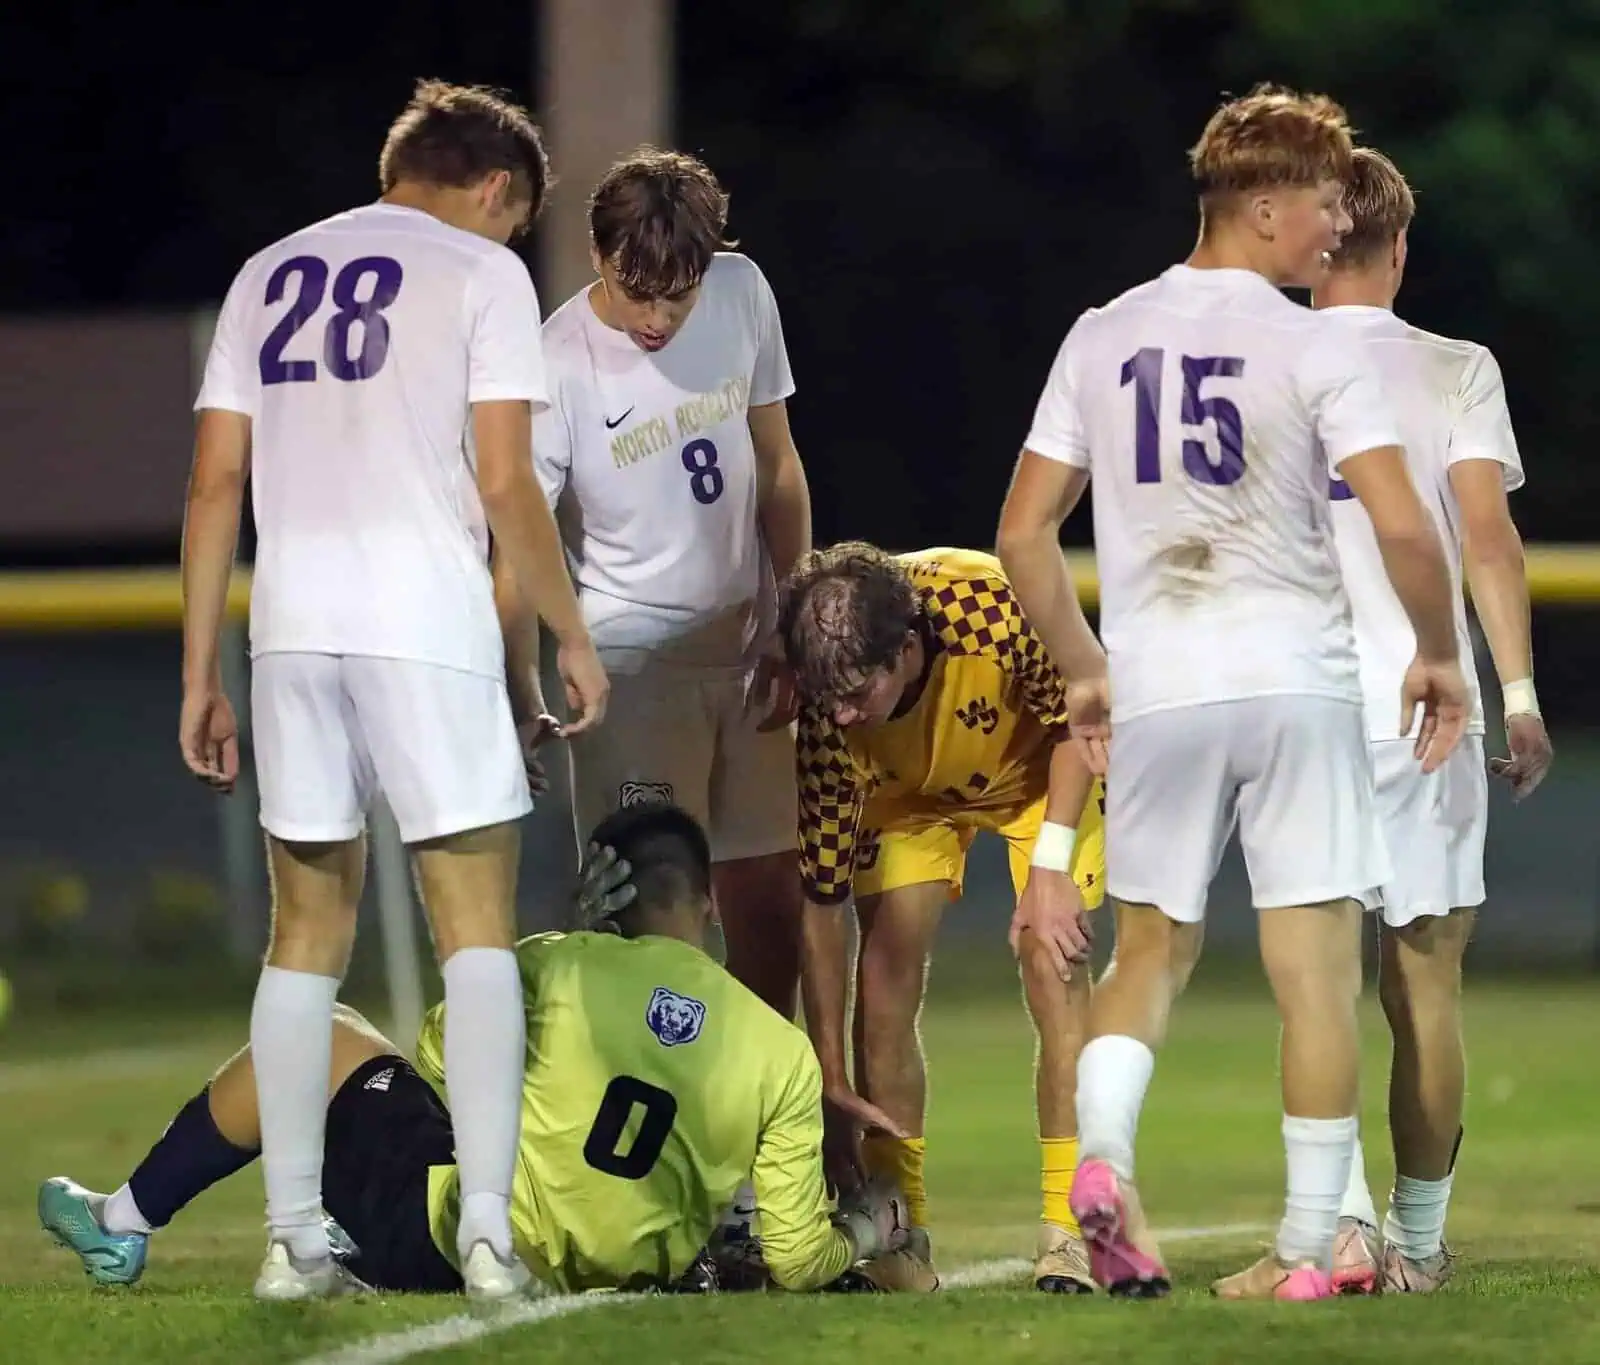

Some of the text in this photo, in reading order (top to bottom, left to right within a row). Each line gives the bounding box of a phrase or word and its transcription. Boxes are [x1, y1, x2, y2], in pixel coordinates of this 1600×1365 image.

[259, 255, 403, 386] 28
[611, 416, 672, 469] NORTH
[1120, 347, 1248, 486] 15
[682, 438, 724, 505] 8
[583, 1074, 678, 1180] 0
